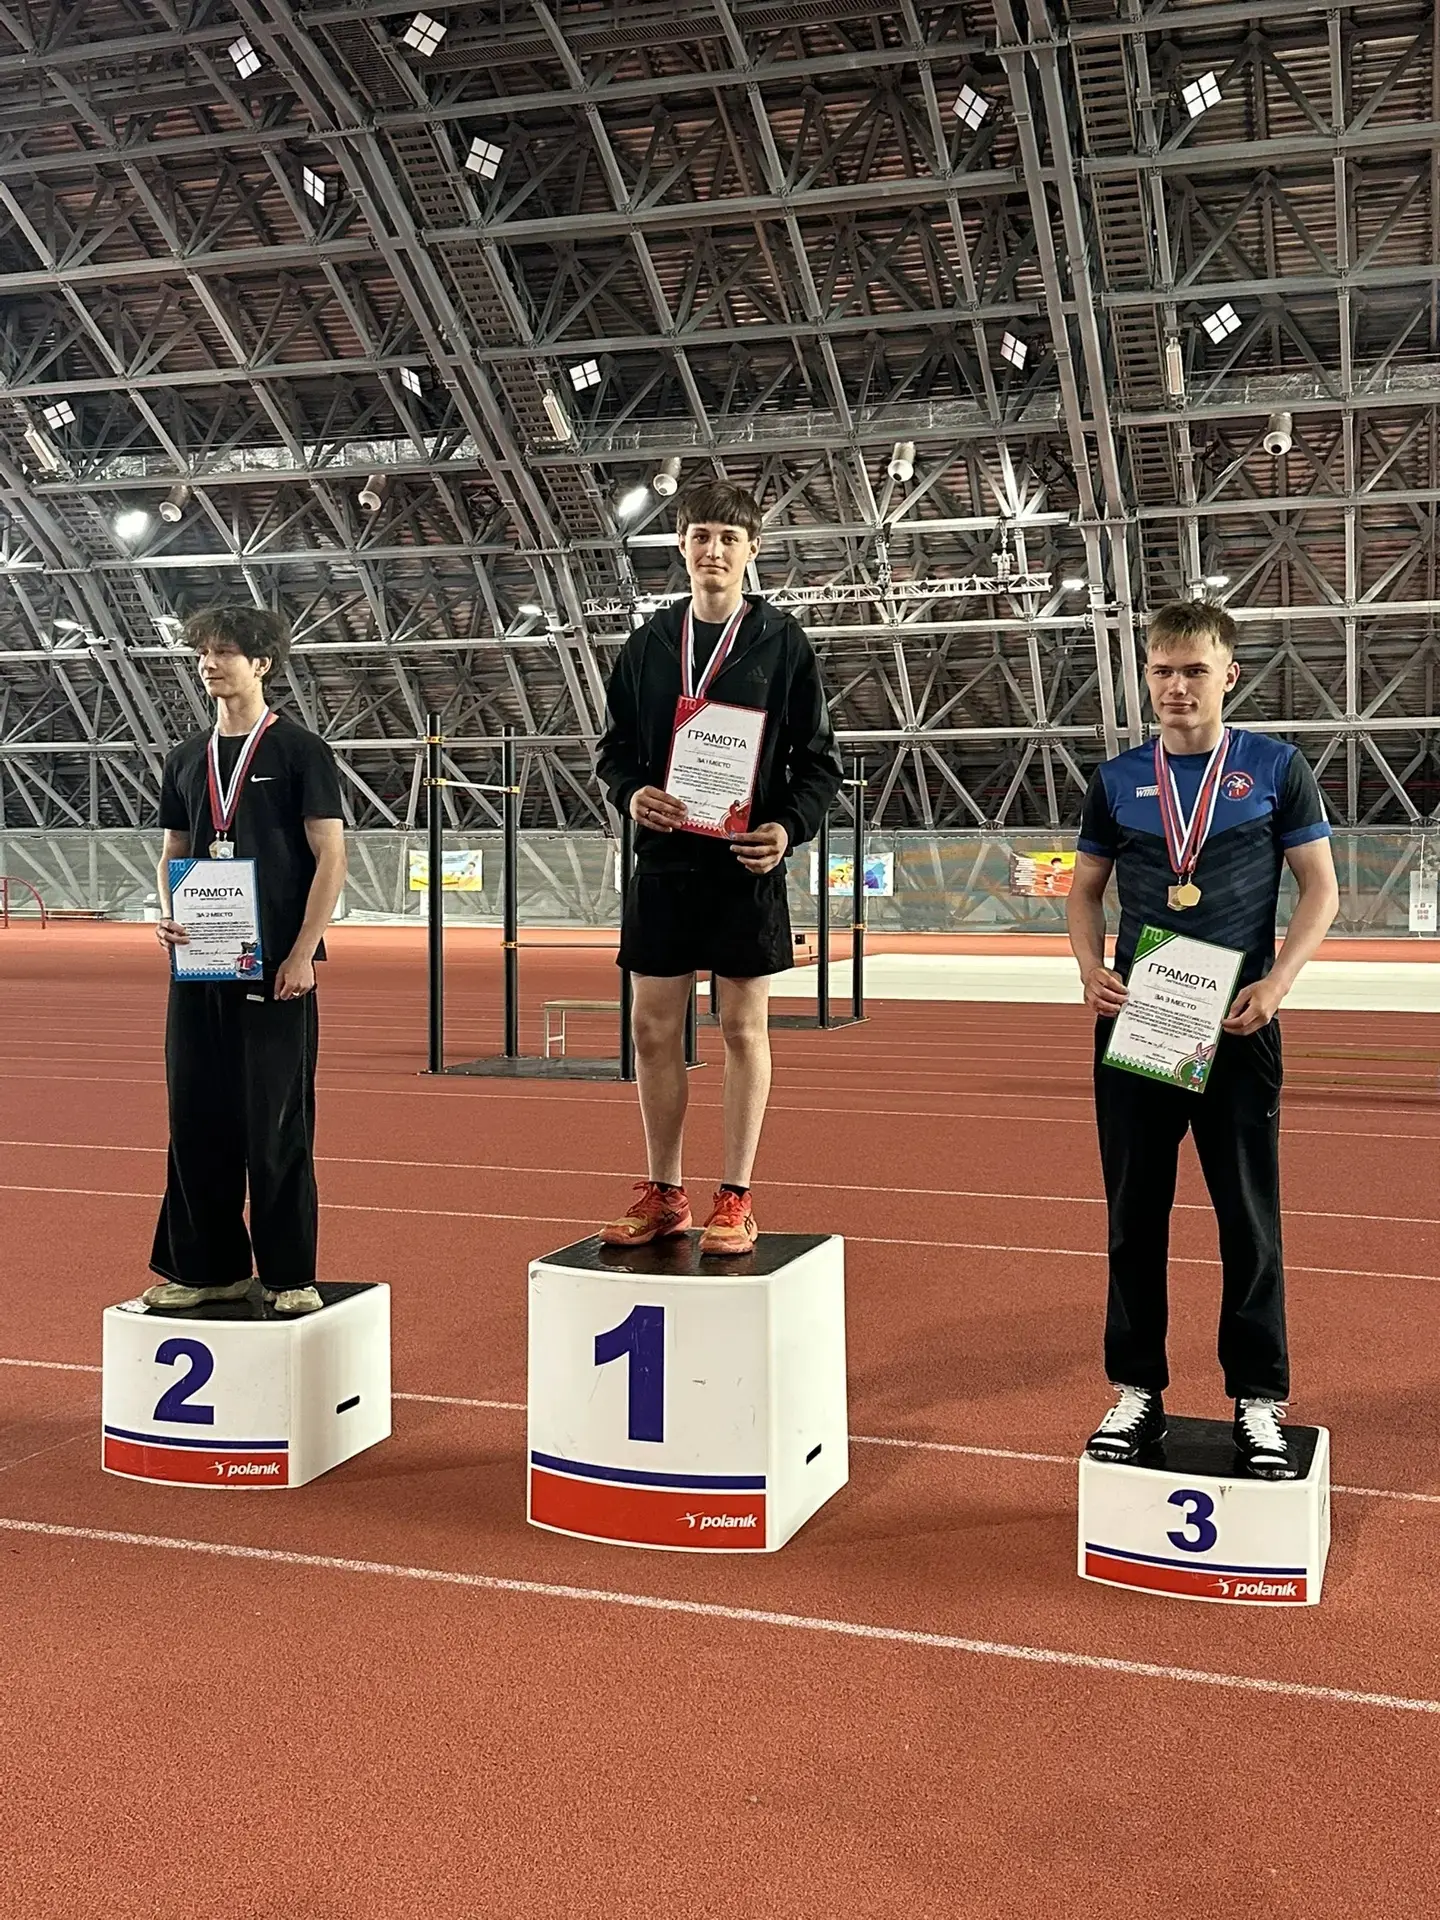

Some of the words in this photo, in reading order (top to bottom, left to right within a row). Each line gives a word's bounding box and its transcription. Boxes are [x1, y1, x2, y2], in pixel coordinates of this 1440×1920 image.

[679, 695, 698, 711] ГТО
[687, 729, 747, 749] ГРАМОТА
[709, 760, 731, 769] МЕСТО
[183, 887, 244, 898] ГРАМОТА
[1142, 925, 1164, 943] ГТО
[1148, 962, 1217, 991] ГРАМОТА
[1154, 993, 1164, 1002] ЗА
[1171, 998, 1197, 1011] МЕСТО
[152, 1338, 216, 1426] 2
[594, 1304, 666, 1443] 1
[227, 1461, 281, 1478] polanik
[699, 1513, 758, 1531] polanik
[1166, 1489, 1218, 1553] 3
[1234, 1580, 1298, 1598] polanik
